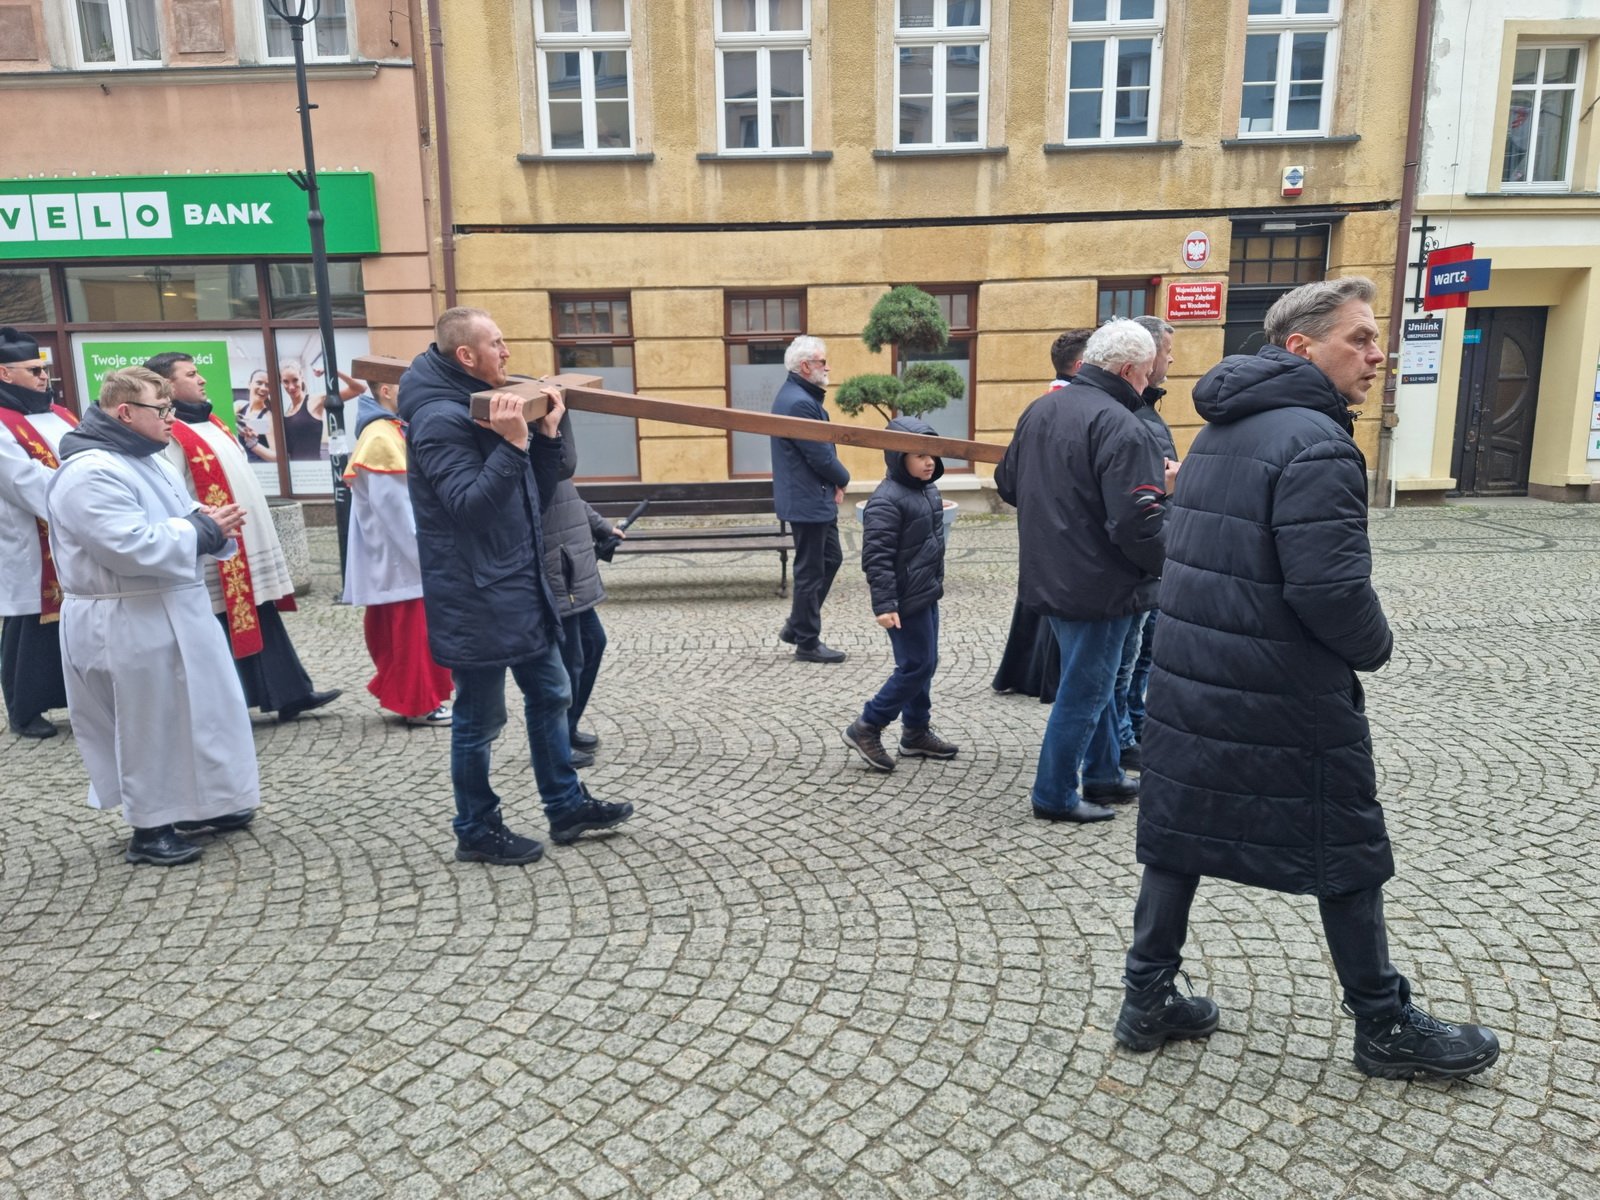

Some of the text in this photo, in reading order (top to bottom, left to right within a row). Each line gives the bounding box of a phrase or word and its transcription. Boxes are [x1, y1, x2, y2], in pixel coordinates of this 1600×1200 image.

[0, 202, 273, 230] VELO BANK
[1434, 270, 1467, 286] warta
[1408, 322, 1439, 331] Unilink
[91, 354, 126, 368] Twoje
